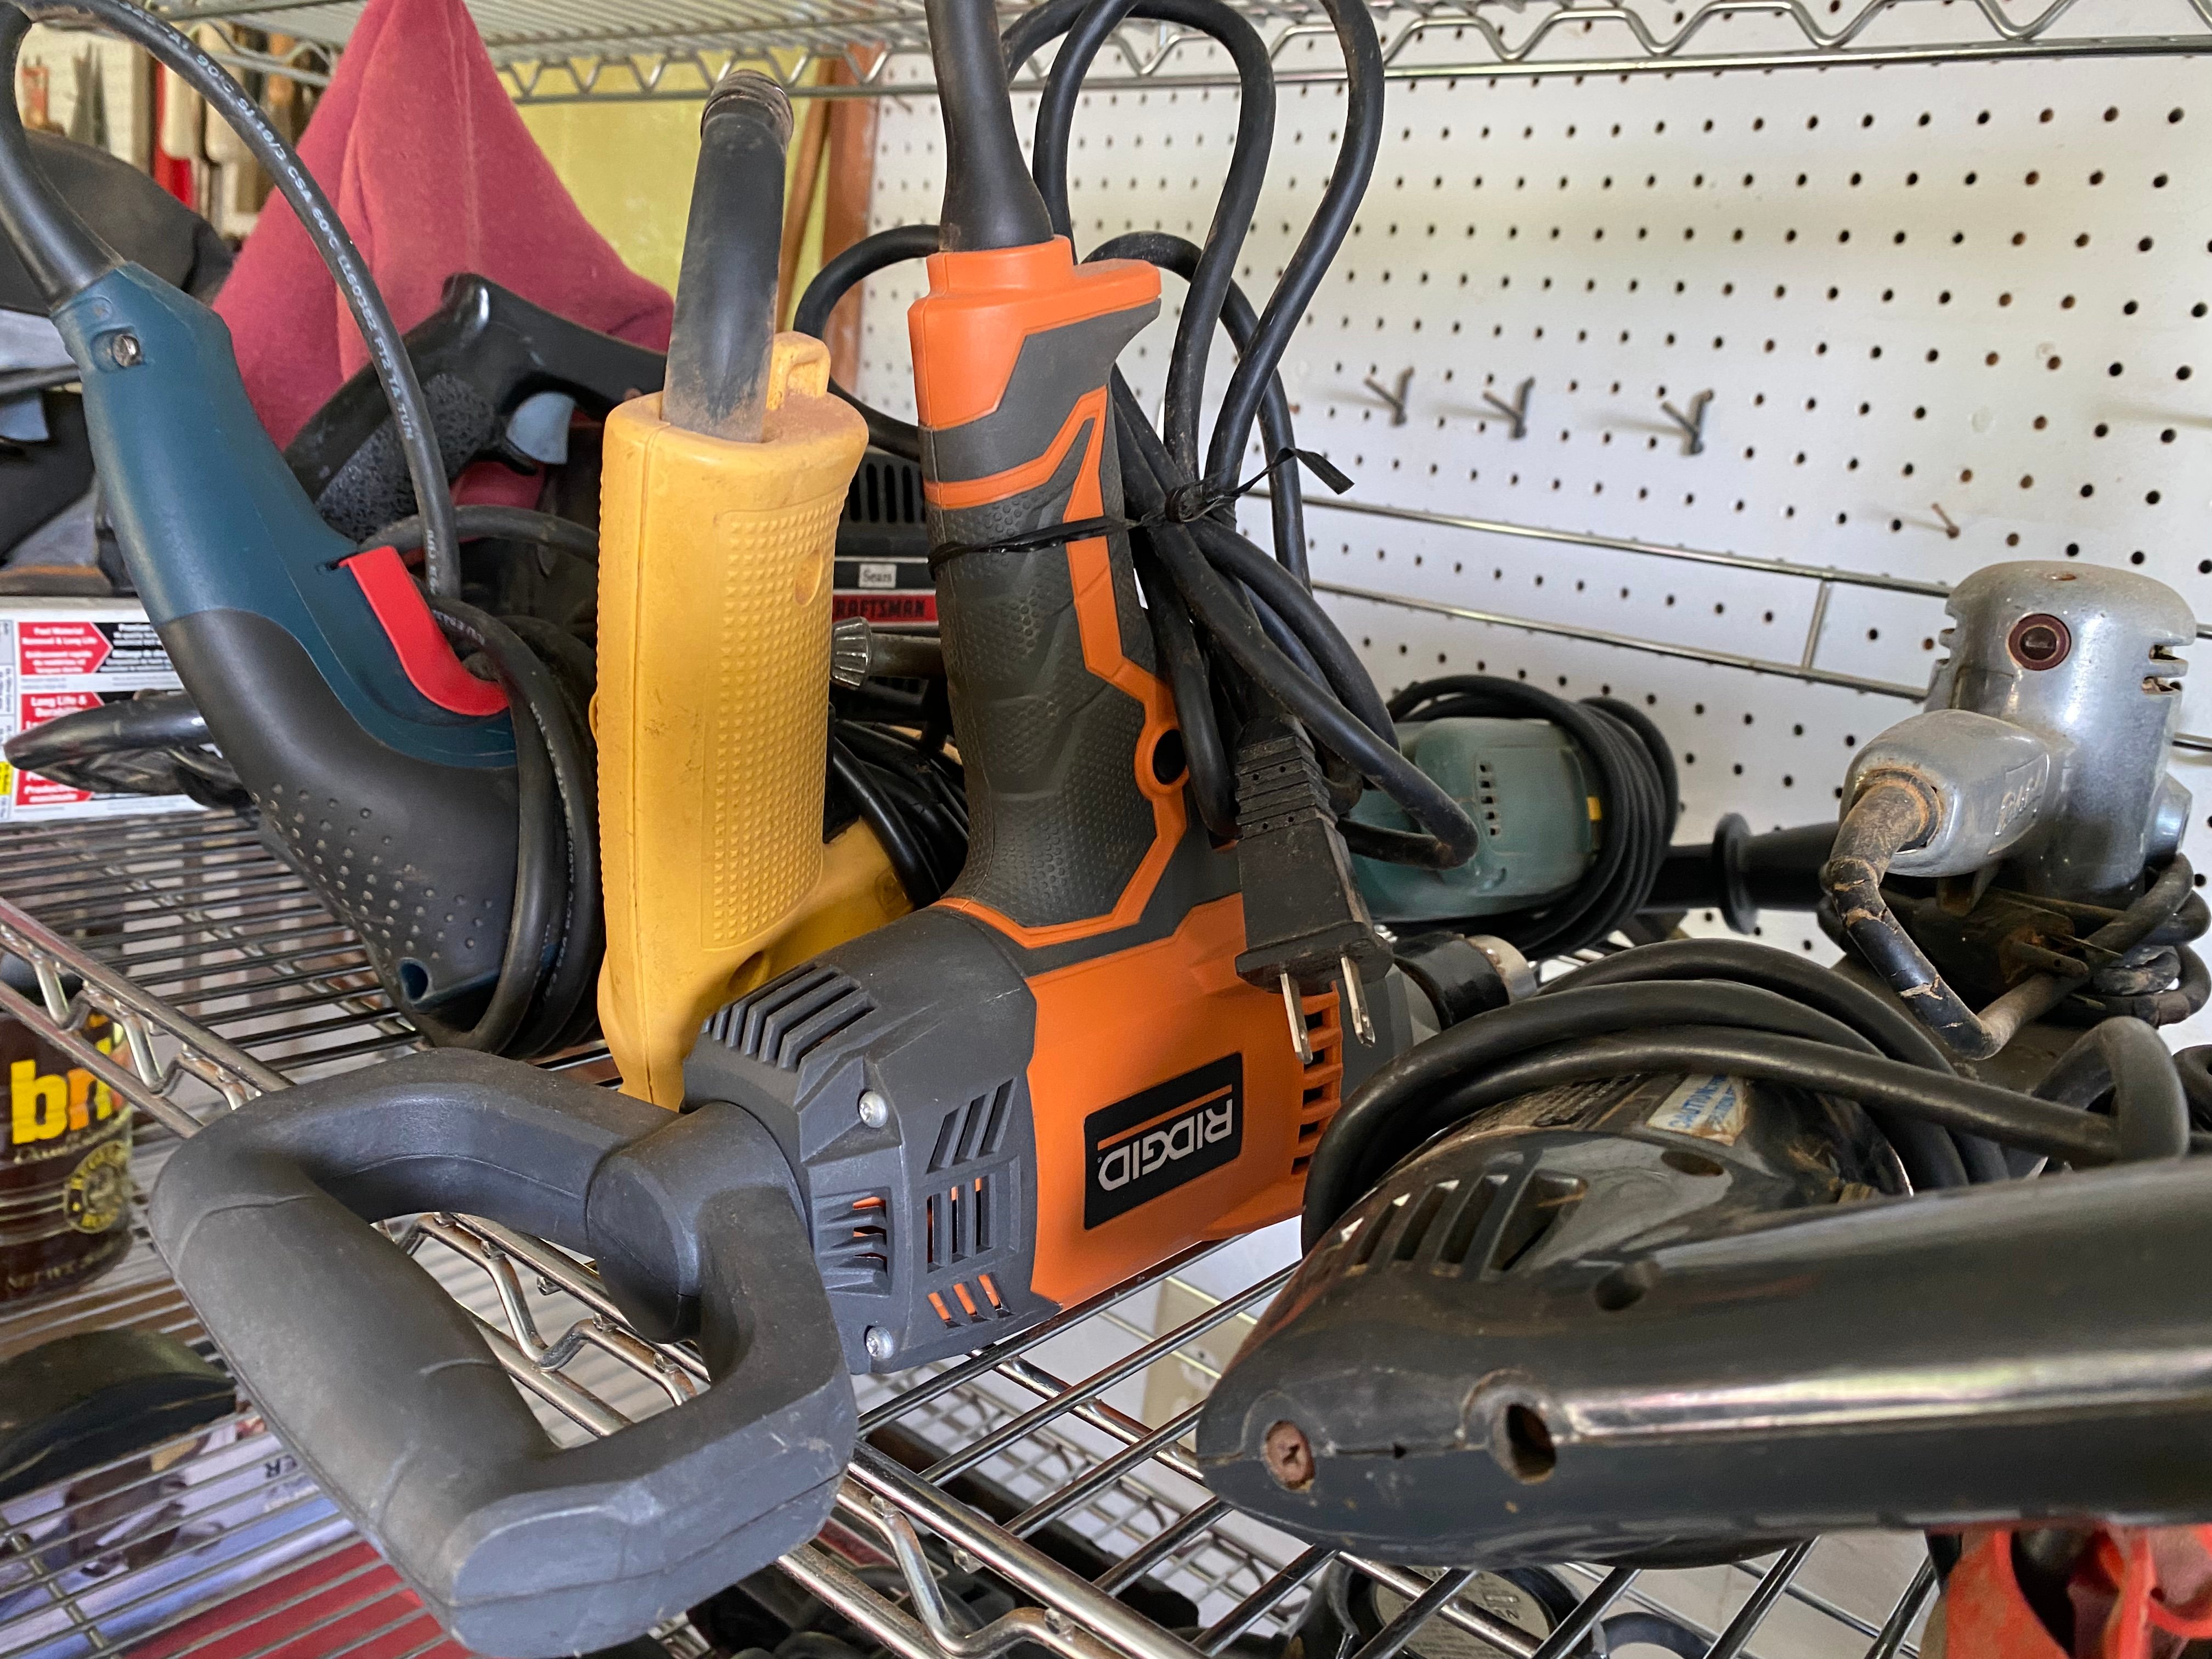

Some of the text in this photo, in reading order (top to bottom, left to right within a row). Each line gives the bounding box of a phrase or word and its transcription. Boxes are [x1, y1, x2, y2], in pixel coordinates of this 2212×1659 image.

[287, 166, 313, 203] CSA
[864, 569, 893, 582] Sears
[833, 599, 926, 618] RAFTSMAN
[1098, 1099, 1233, 1191] RIDGID
